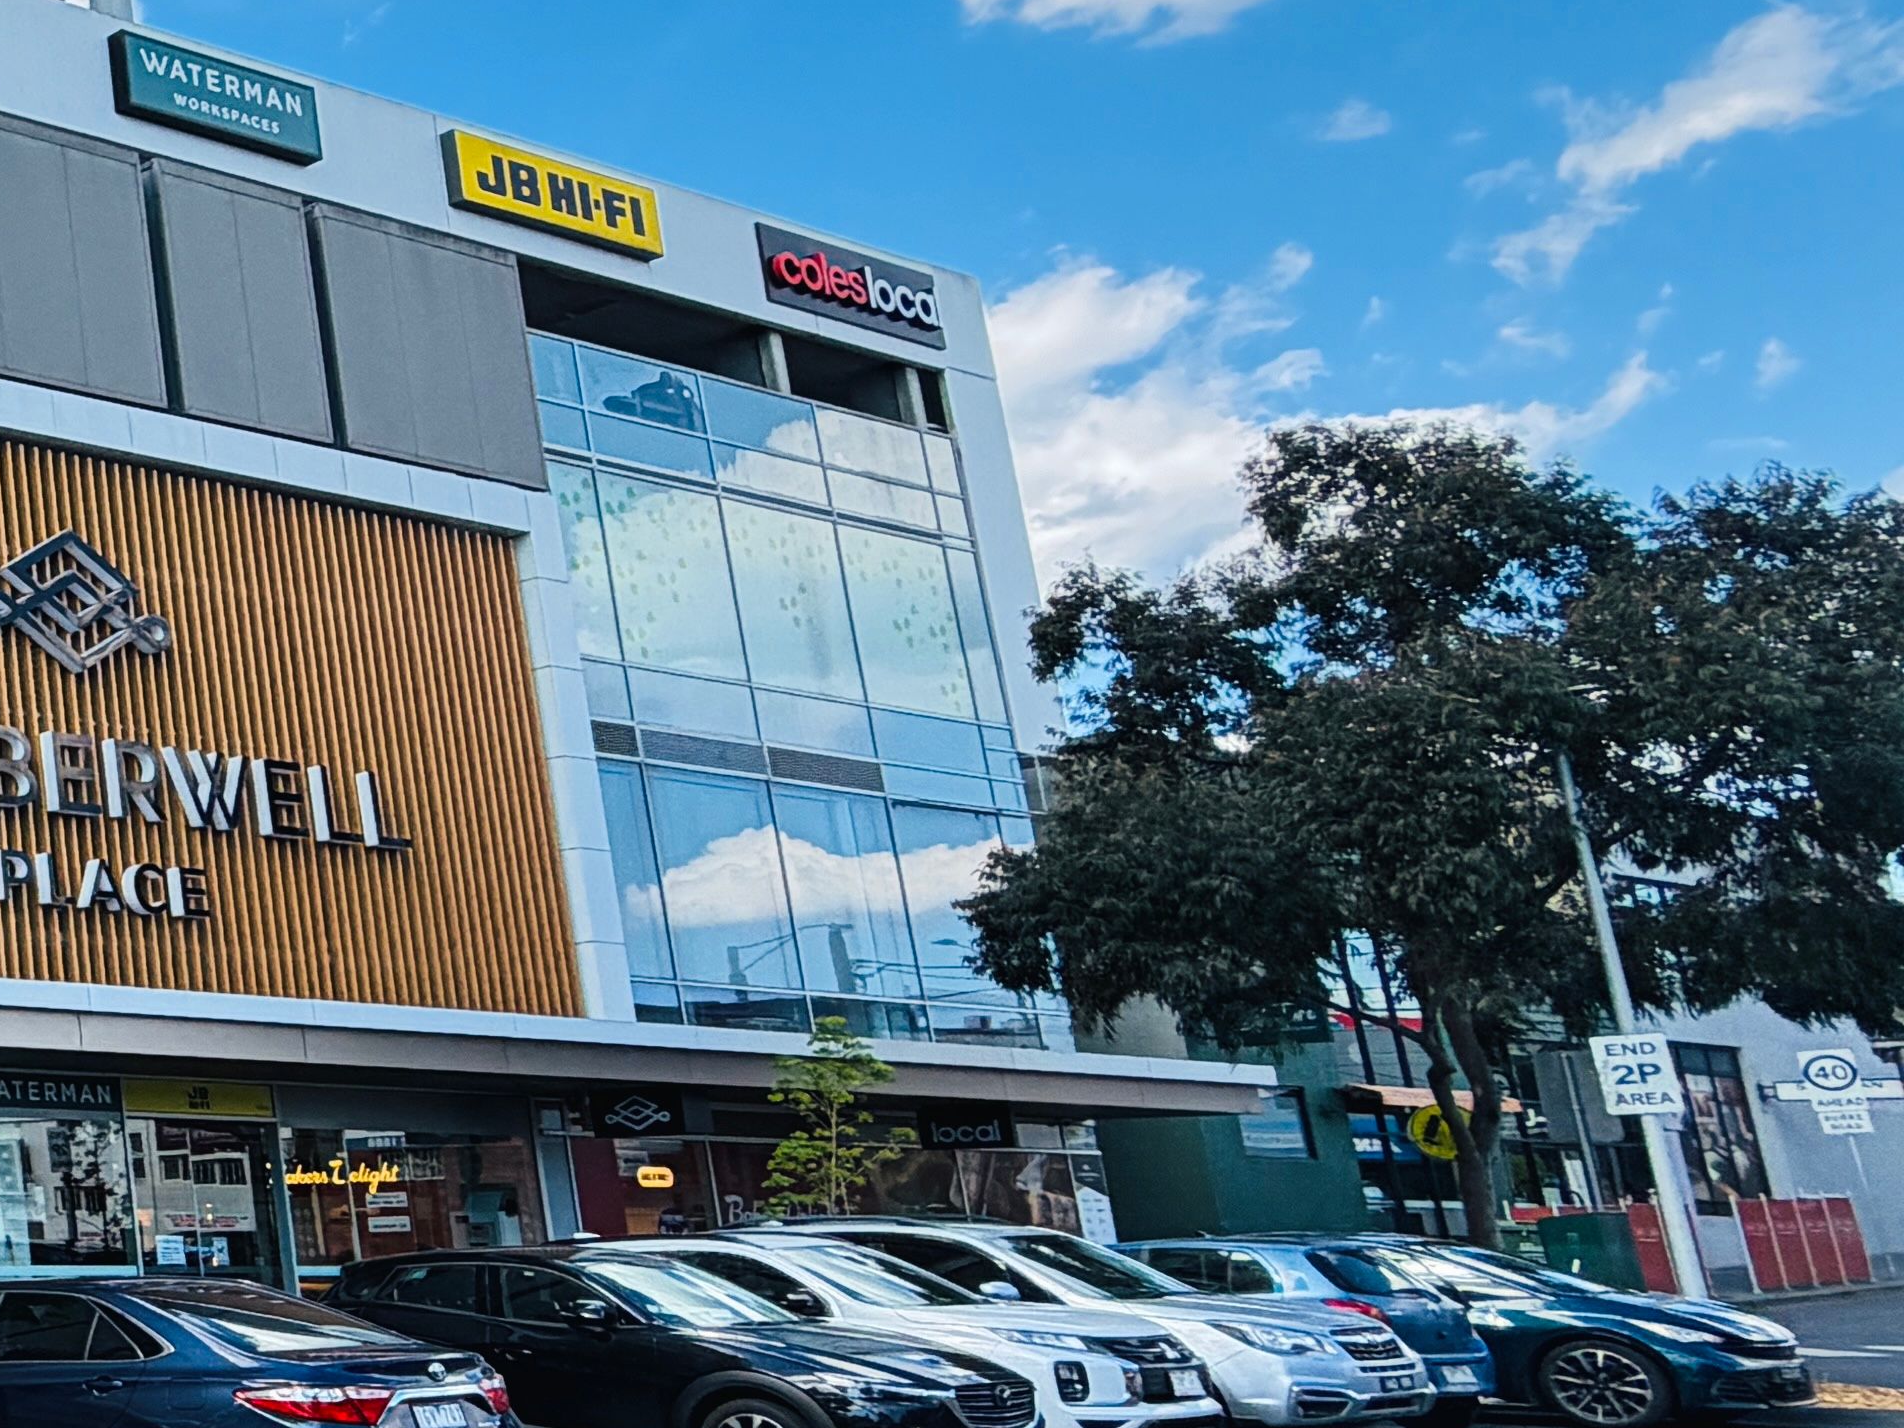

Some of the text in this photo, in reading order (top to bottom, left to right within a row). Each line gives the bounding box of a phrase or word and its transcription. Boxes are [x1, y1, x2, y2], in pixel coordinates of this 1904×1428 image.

[139, 48, 304, 117] WATERMAN
[173, 92, 280, 134] WORKSPACES
[476, 154, 646, 237] JB HI-FI
[1603, 1042, 1657, 1057] END
[1610, 1063, 1662, 1086] 2P
[1814, 1064, 1849, 1081] 40
[1615, 1092, 1677, 1107] AREA
[930, 1118, 1002, 1143] local
[270, 1163, 329, 1185] akers
